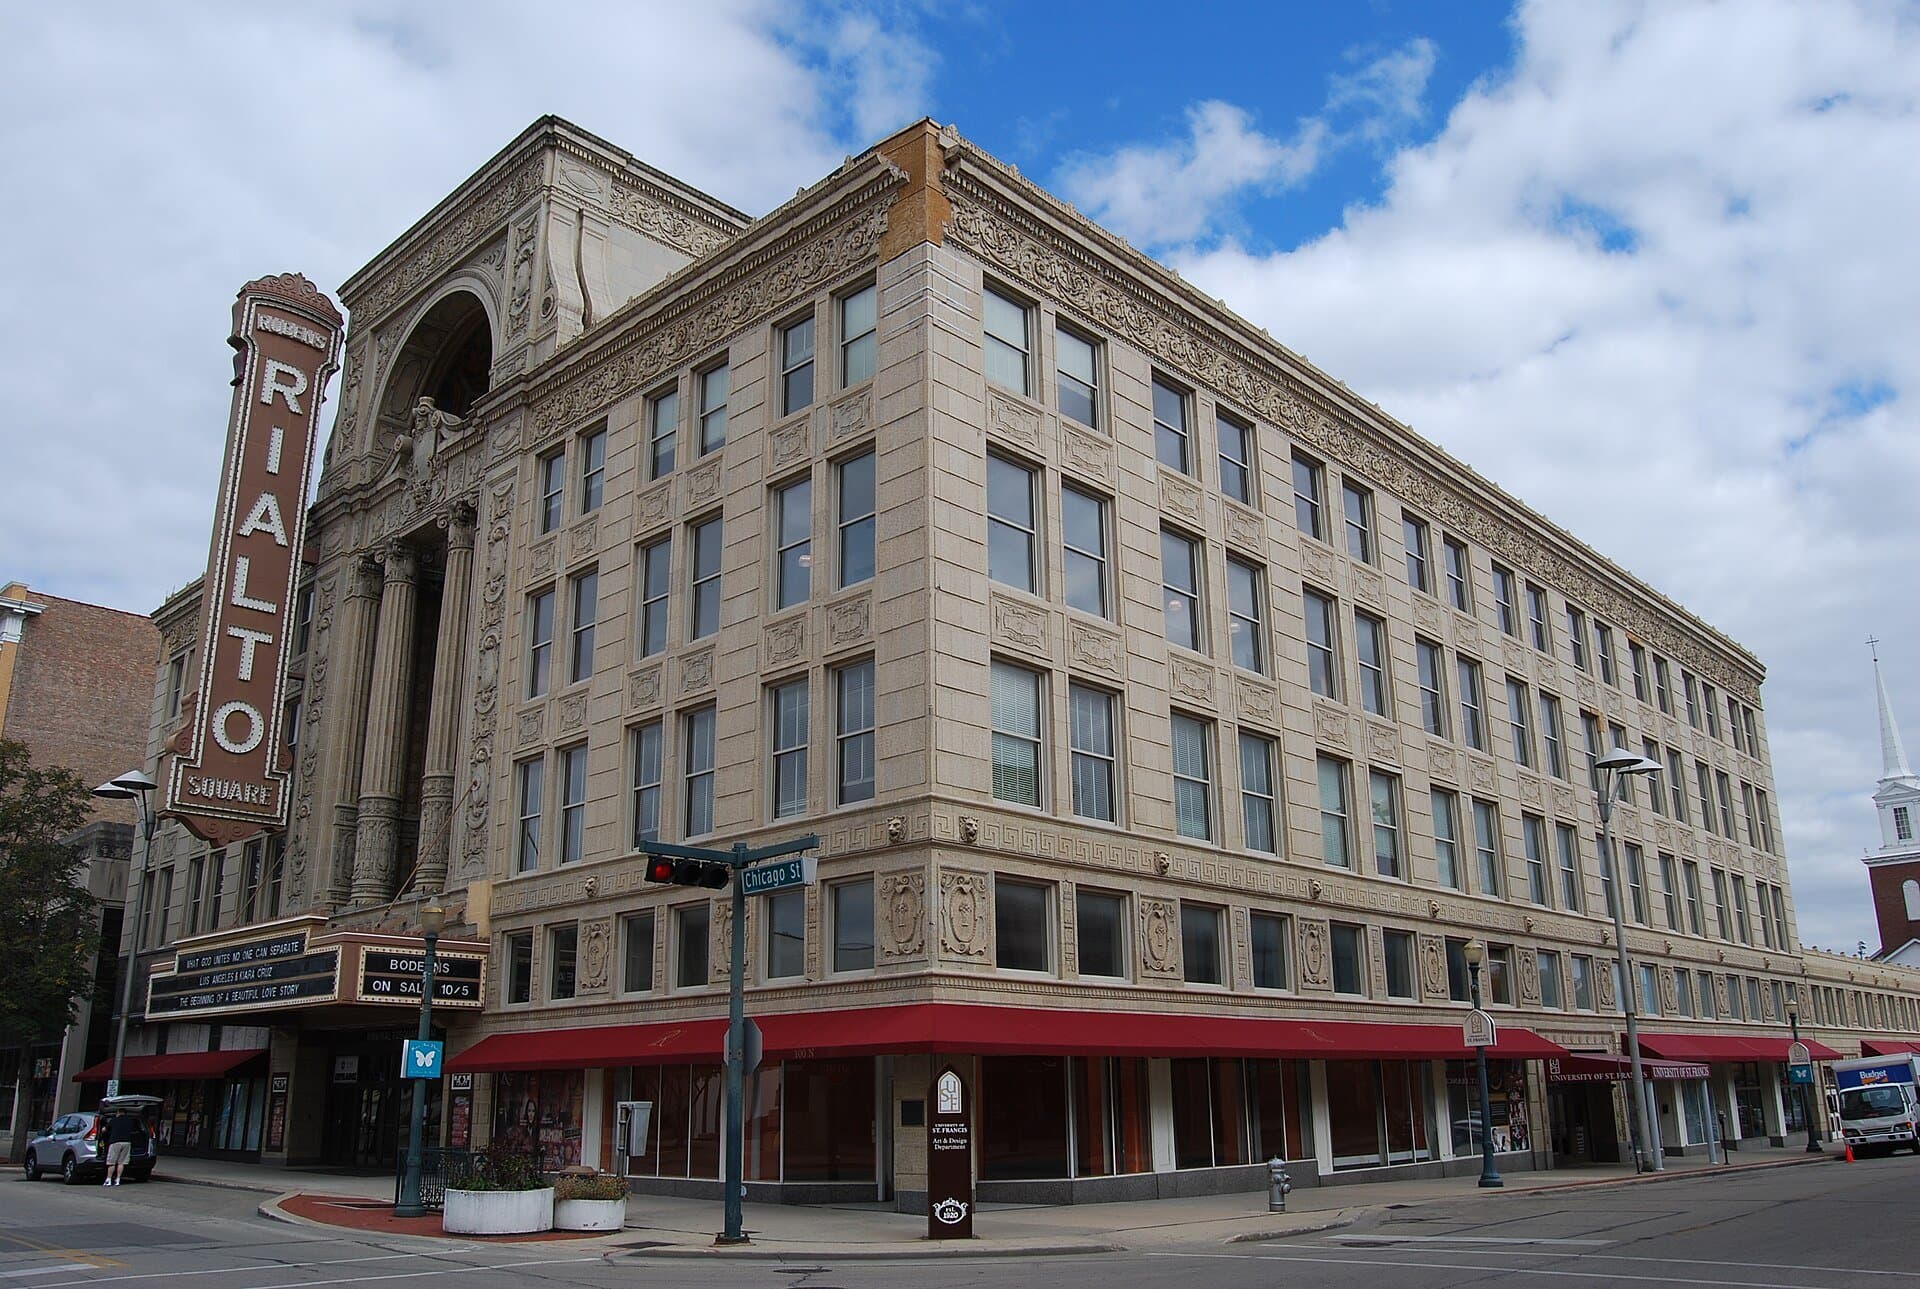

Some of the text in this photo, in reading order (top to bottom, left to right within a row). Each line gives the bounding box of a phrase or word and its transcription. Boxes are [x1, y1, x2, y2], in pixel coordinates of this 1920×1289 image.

[257, 313, 327, 351] RUBENS
[211, 357, 307, 753] RIALTO
[187, 775, 272, 806] SQUARE
[745, 862, 801, 887] Chicago St
[187, 941, 299, 969] WHAT GOD UNITES NO ONE CAN SEPARATE
[257, 966, 273, 978] CRUZ
[390, 959, 450, 974] BODENS
[180, 997, 188, 1007] THE
[190, 995, 214, 1006] BEGINNING
[216, 992, 224, 1003] OF
[231, 989, 258, 1001] BEAUTIFUL
[262, 986, 277, 998] LOVE
[280, 983, 300, 996] STORY
[372, 980, 469, 996] ON SAL 10/5
[1550, 1073, 1592, 1082] UNIVERSITY
[1593, 1072, 1603, 1080] OF
[1652, 1066, 1679, 1078] UNIVERSITY
[1691, 1066, 1710, 1077] FRANCIS
[1859, 1069, 1887, 1080] Budget
[949, 1137, 967, 1145] Design
